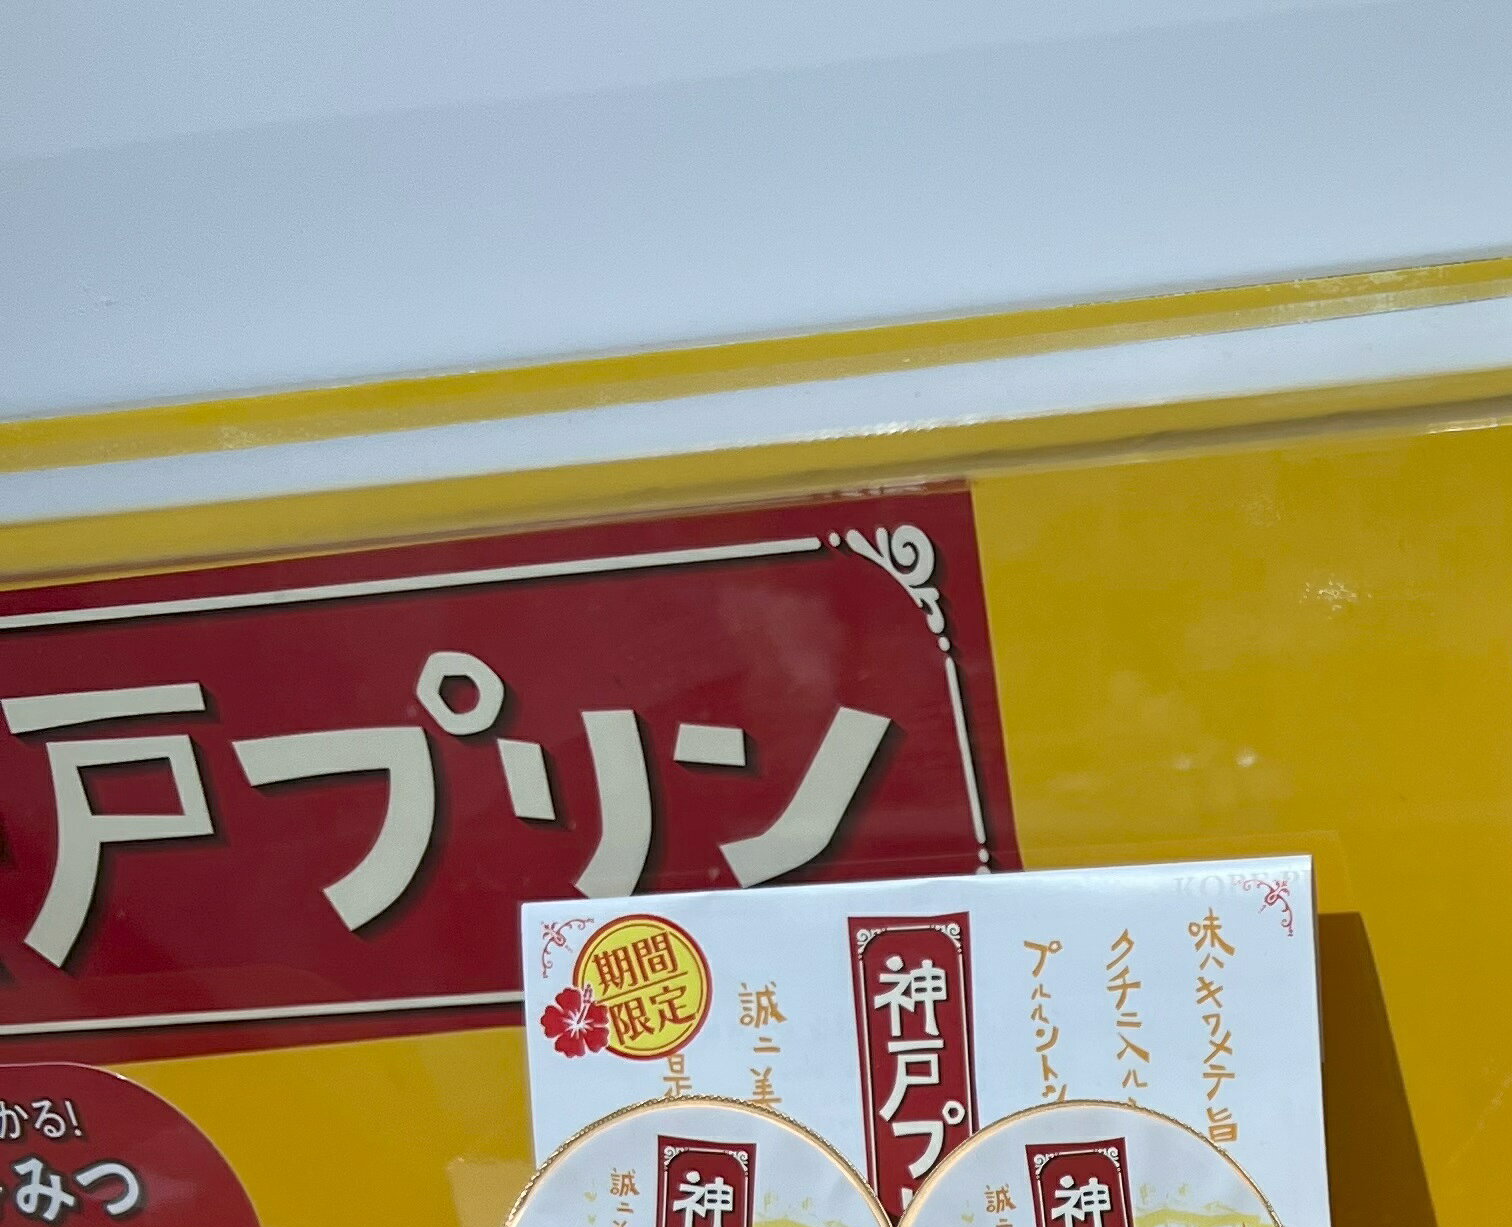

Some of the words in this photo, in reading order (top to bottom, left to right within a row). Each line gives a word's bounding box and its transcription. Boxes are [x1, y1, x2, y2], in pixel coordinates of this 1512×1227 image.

[592, 930, 683, 993] 期間
[607, 984, 698, 1047] 限定
[872, 955, 967, 1213] 神戸プ
